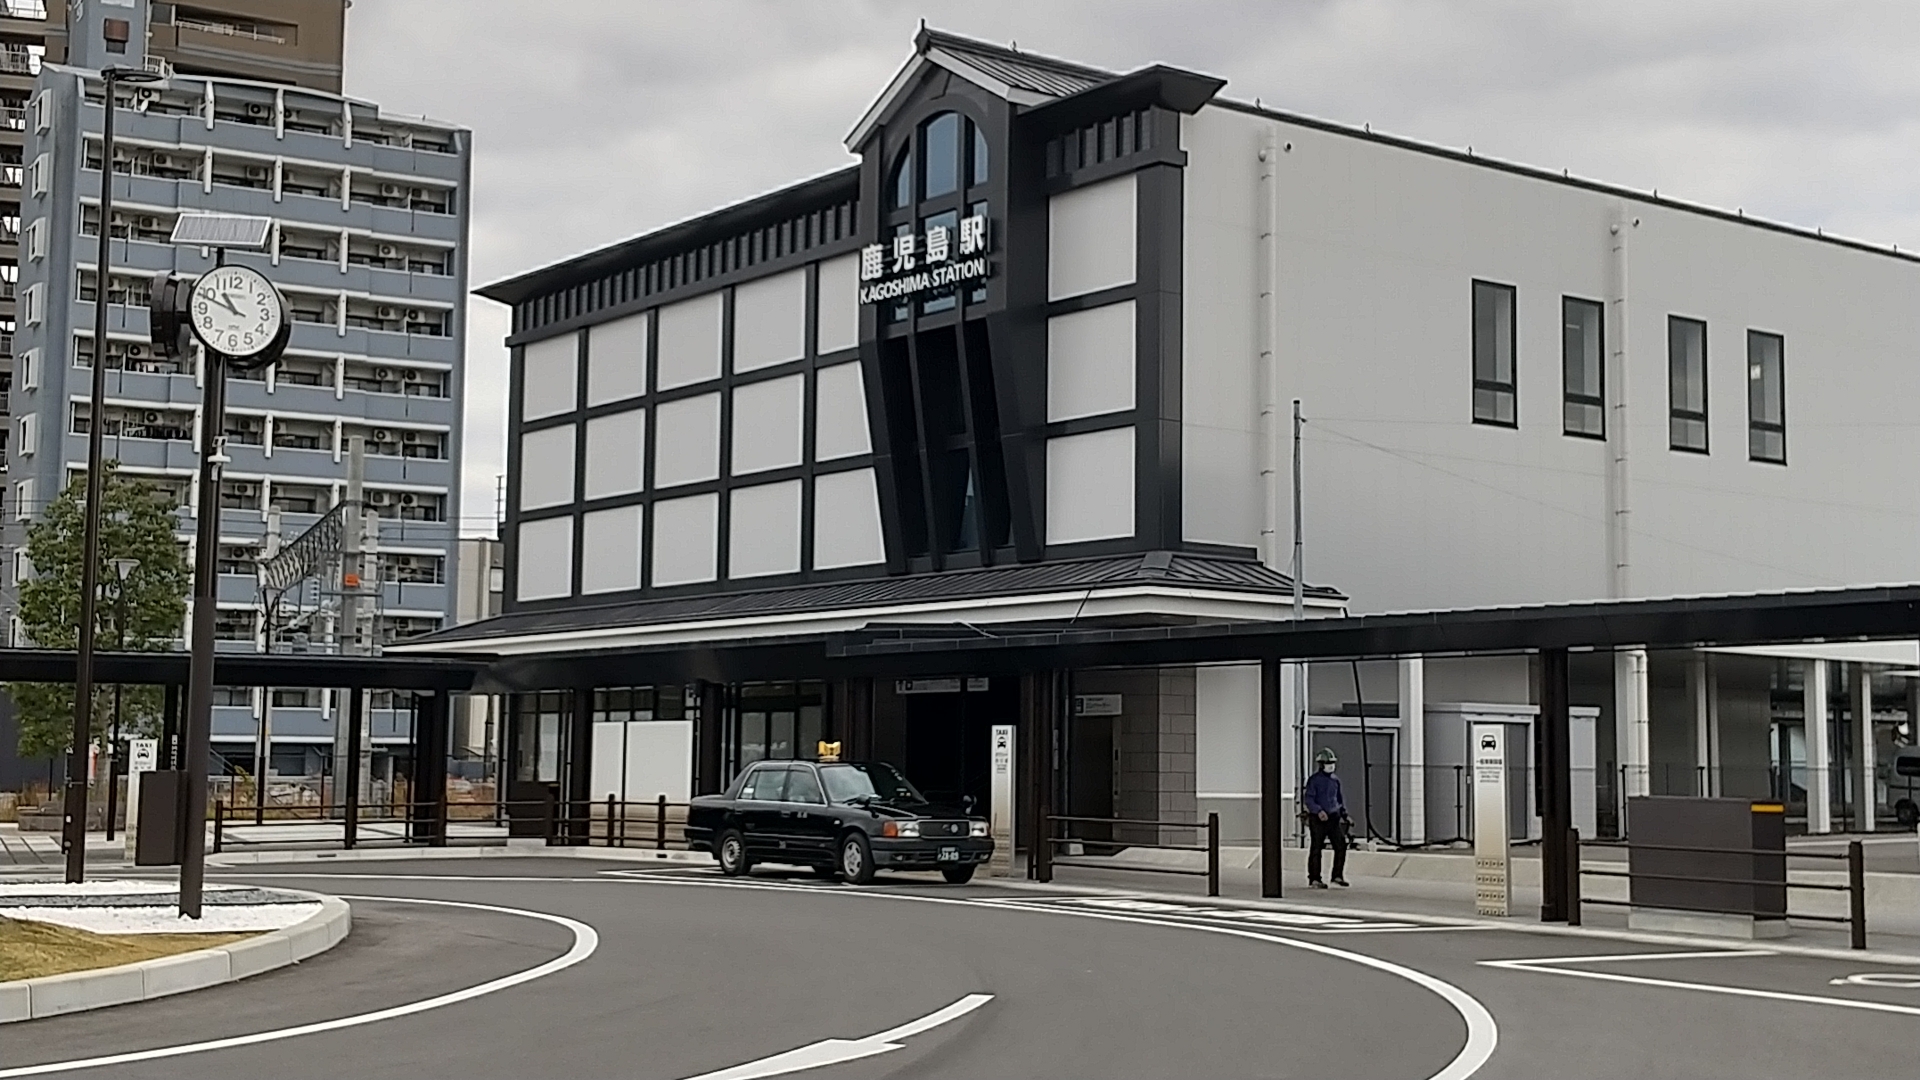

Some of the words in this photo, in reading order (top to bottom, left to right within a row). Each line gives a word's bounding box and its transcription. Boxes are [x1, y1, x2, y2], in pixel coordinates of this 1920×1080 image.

[861, 214, 986, 281] 鹿児島駅
[216, 277, 227, 290] 11
[229, 276, 244, 290] 12
[249, 281, 254, 294] 1
[860, 272, 931, 305] KAGOSHIMA
[932, 257, 985, 287] STATION
[200, 286, 216, 301] 10
[256, 292, 266, 306] 2
[198, 302, 208, 315] 9
[260, 308, 270, 322] 3
[203, 316, 213, 329] 8
[255, 323, 265, 335] 4
[215, 329, 225, 342] 7
[228, 334, 238, 348] 6
[243, 332, 253, 345] 5
